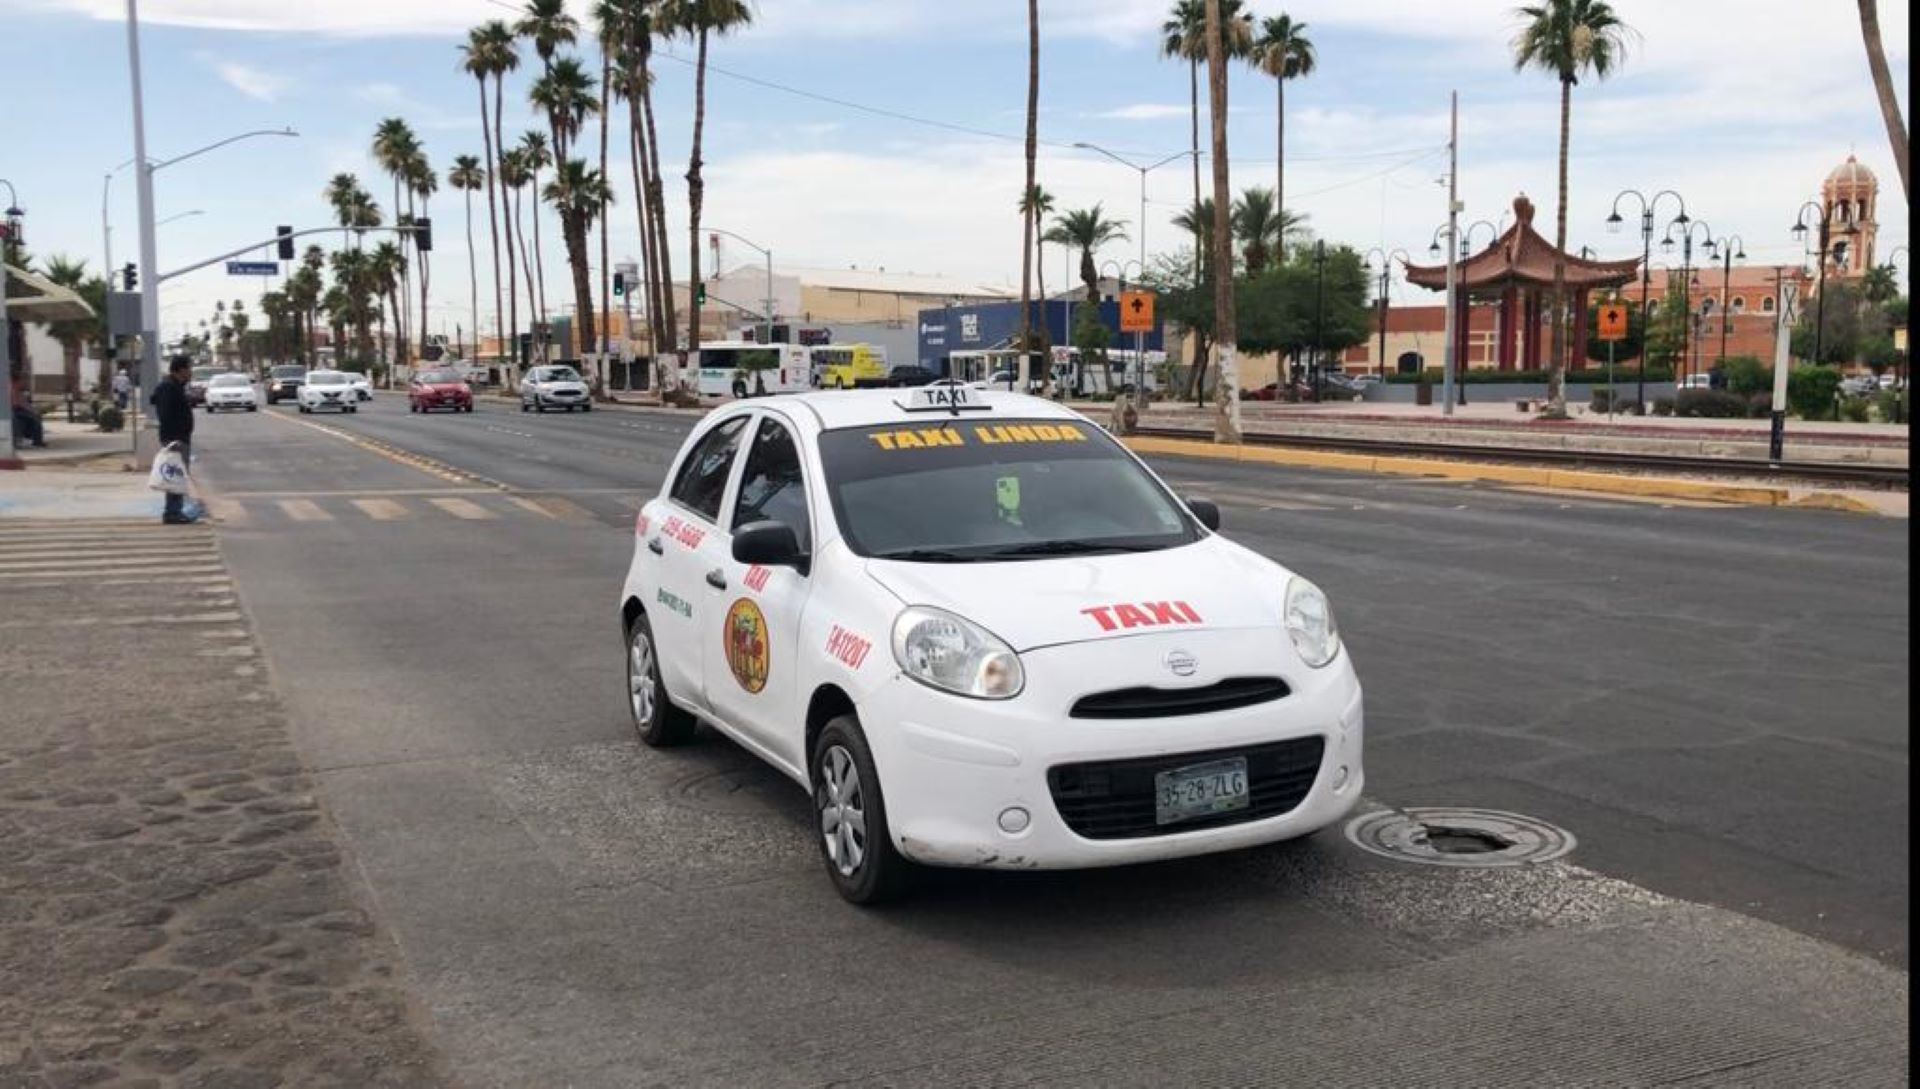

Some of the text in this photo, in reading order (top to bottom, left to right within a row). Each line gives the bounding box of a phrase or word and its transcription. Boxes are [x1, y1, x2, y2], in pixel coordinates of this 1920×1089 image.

[923, 390, 968, 405] TAXI
[869, 424, 1088, 449] TAXI LINDA
[1080, 600, 1203, 631] TAXI
